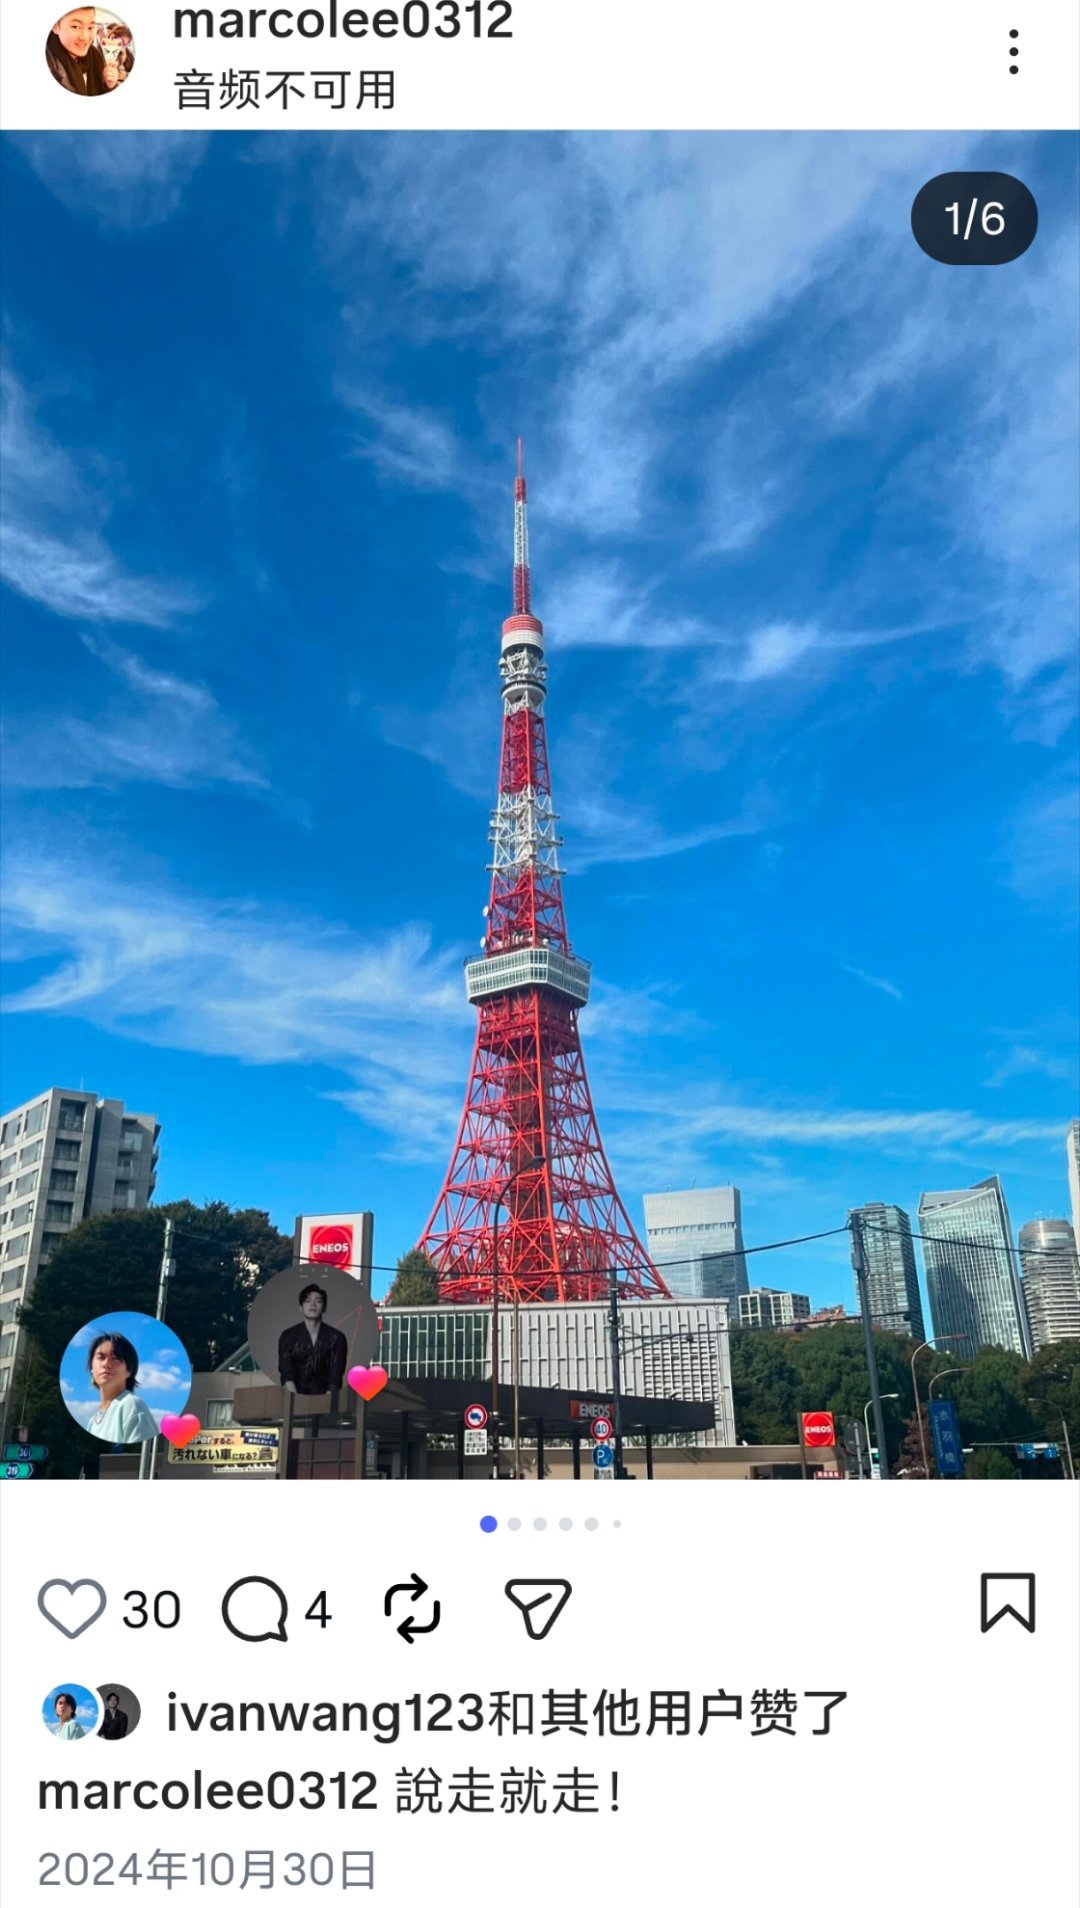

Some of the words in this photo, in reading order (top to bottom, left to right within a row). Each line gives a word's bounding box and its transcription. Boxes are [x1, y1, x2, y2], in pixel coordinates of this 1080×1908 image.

[312, 1242, 349, 1254] ENEOS
[579, 1403, 611, 1418] ENEOS
[595, 1424, 607, 1435] 40
[805, 1425, 832, 1434] ENEOS
